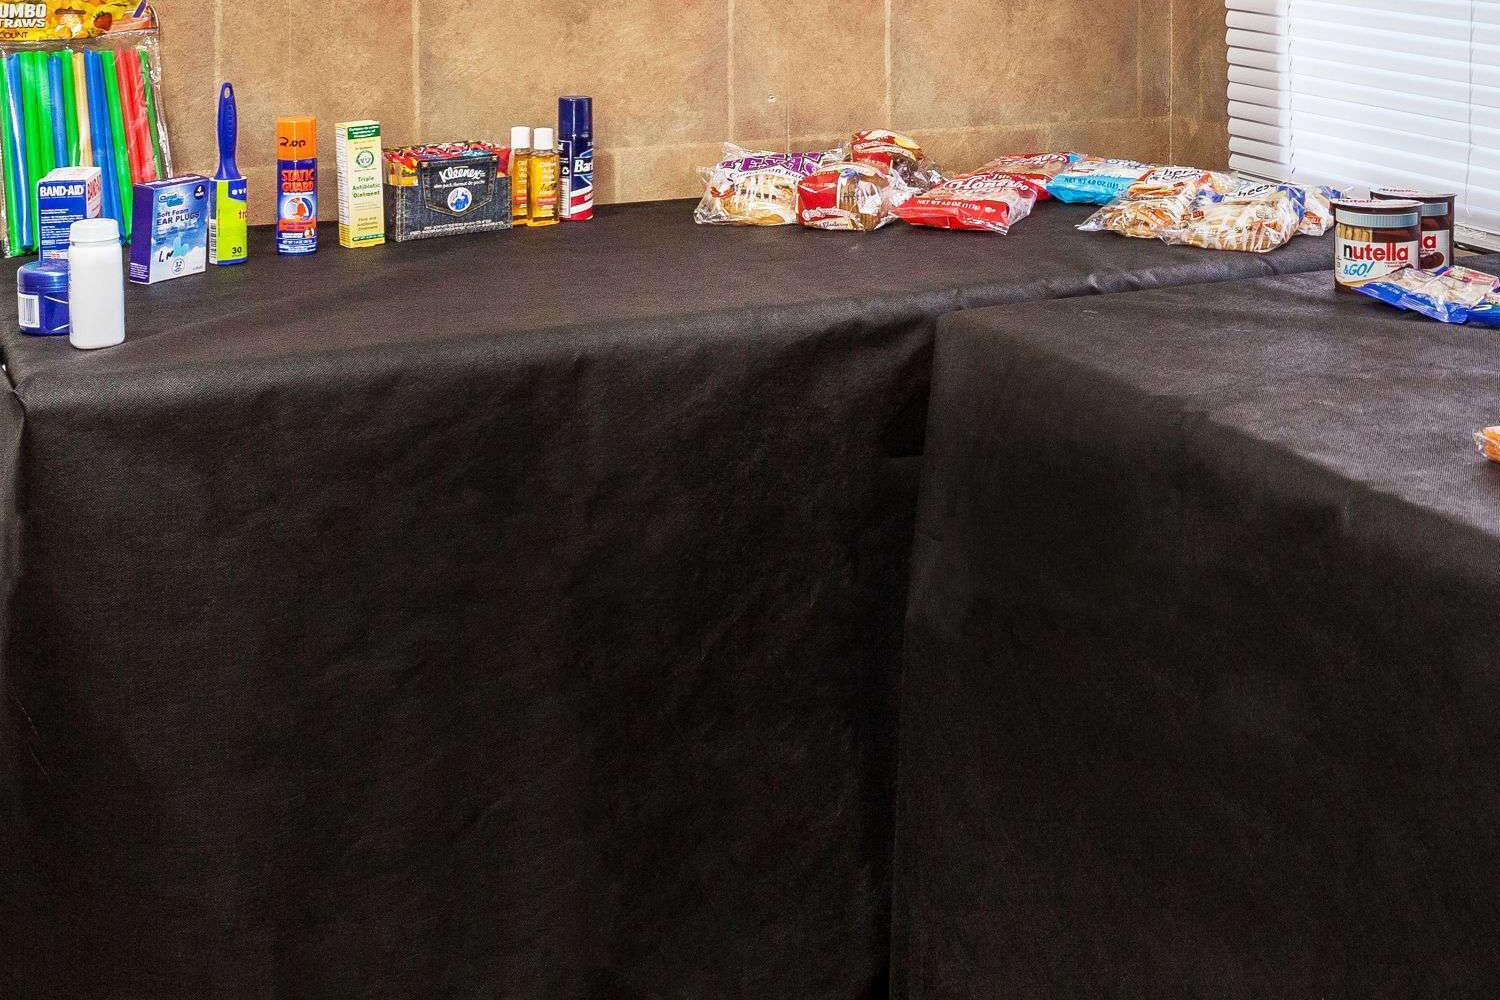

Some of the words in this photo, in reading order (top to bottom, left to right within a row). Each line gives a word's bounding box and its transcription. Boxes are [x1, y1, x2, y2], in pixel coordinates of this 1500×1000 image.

[281, 169, 315, 181] STATIC
[439, 166, 485, 183] Kleenex
[40, 184, 84, 197] BAND-AID
[281, 181, 315, 192] GUARD
[352, 183, 381, 191] Antibiotic
[352, 190, 380, 199] Ointment
[157, 210, 171, 218] Soft
[157, 217, 174, 226] EAR
[175, 212, 200, 222] PLUGS
[231, 246, 242, 255] 30
[1343, 242, 1409, 262] nutella
